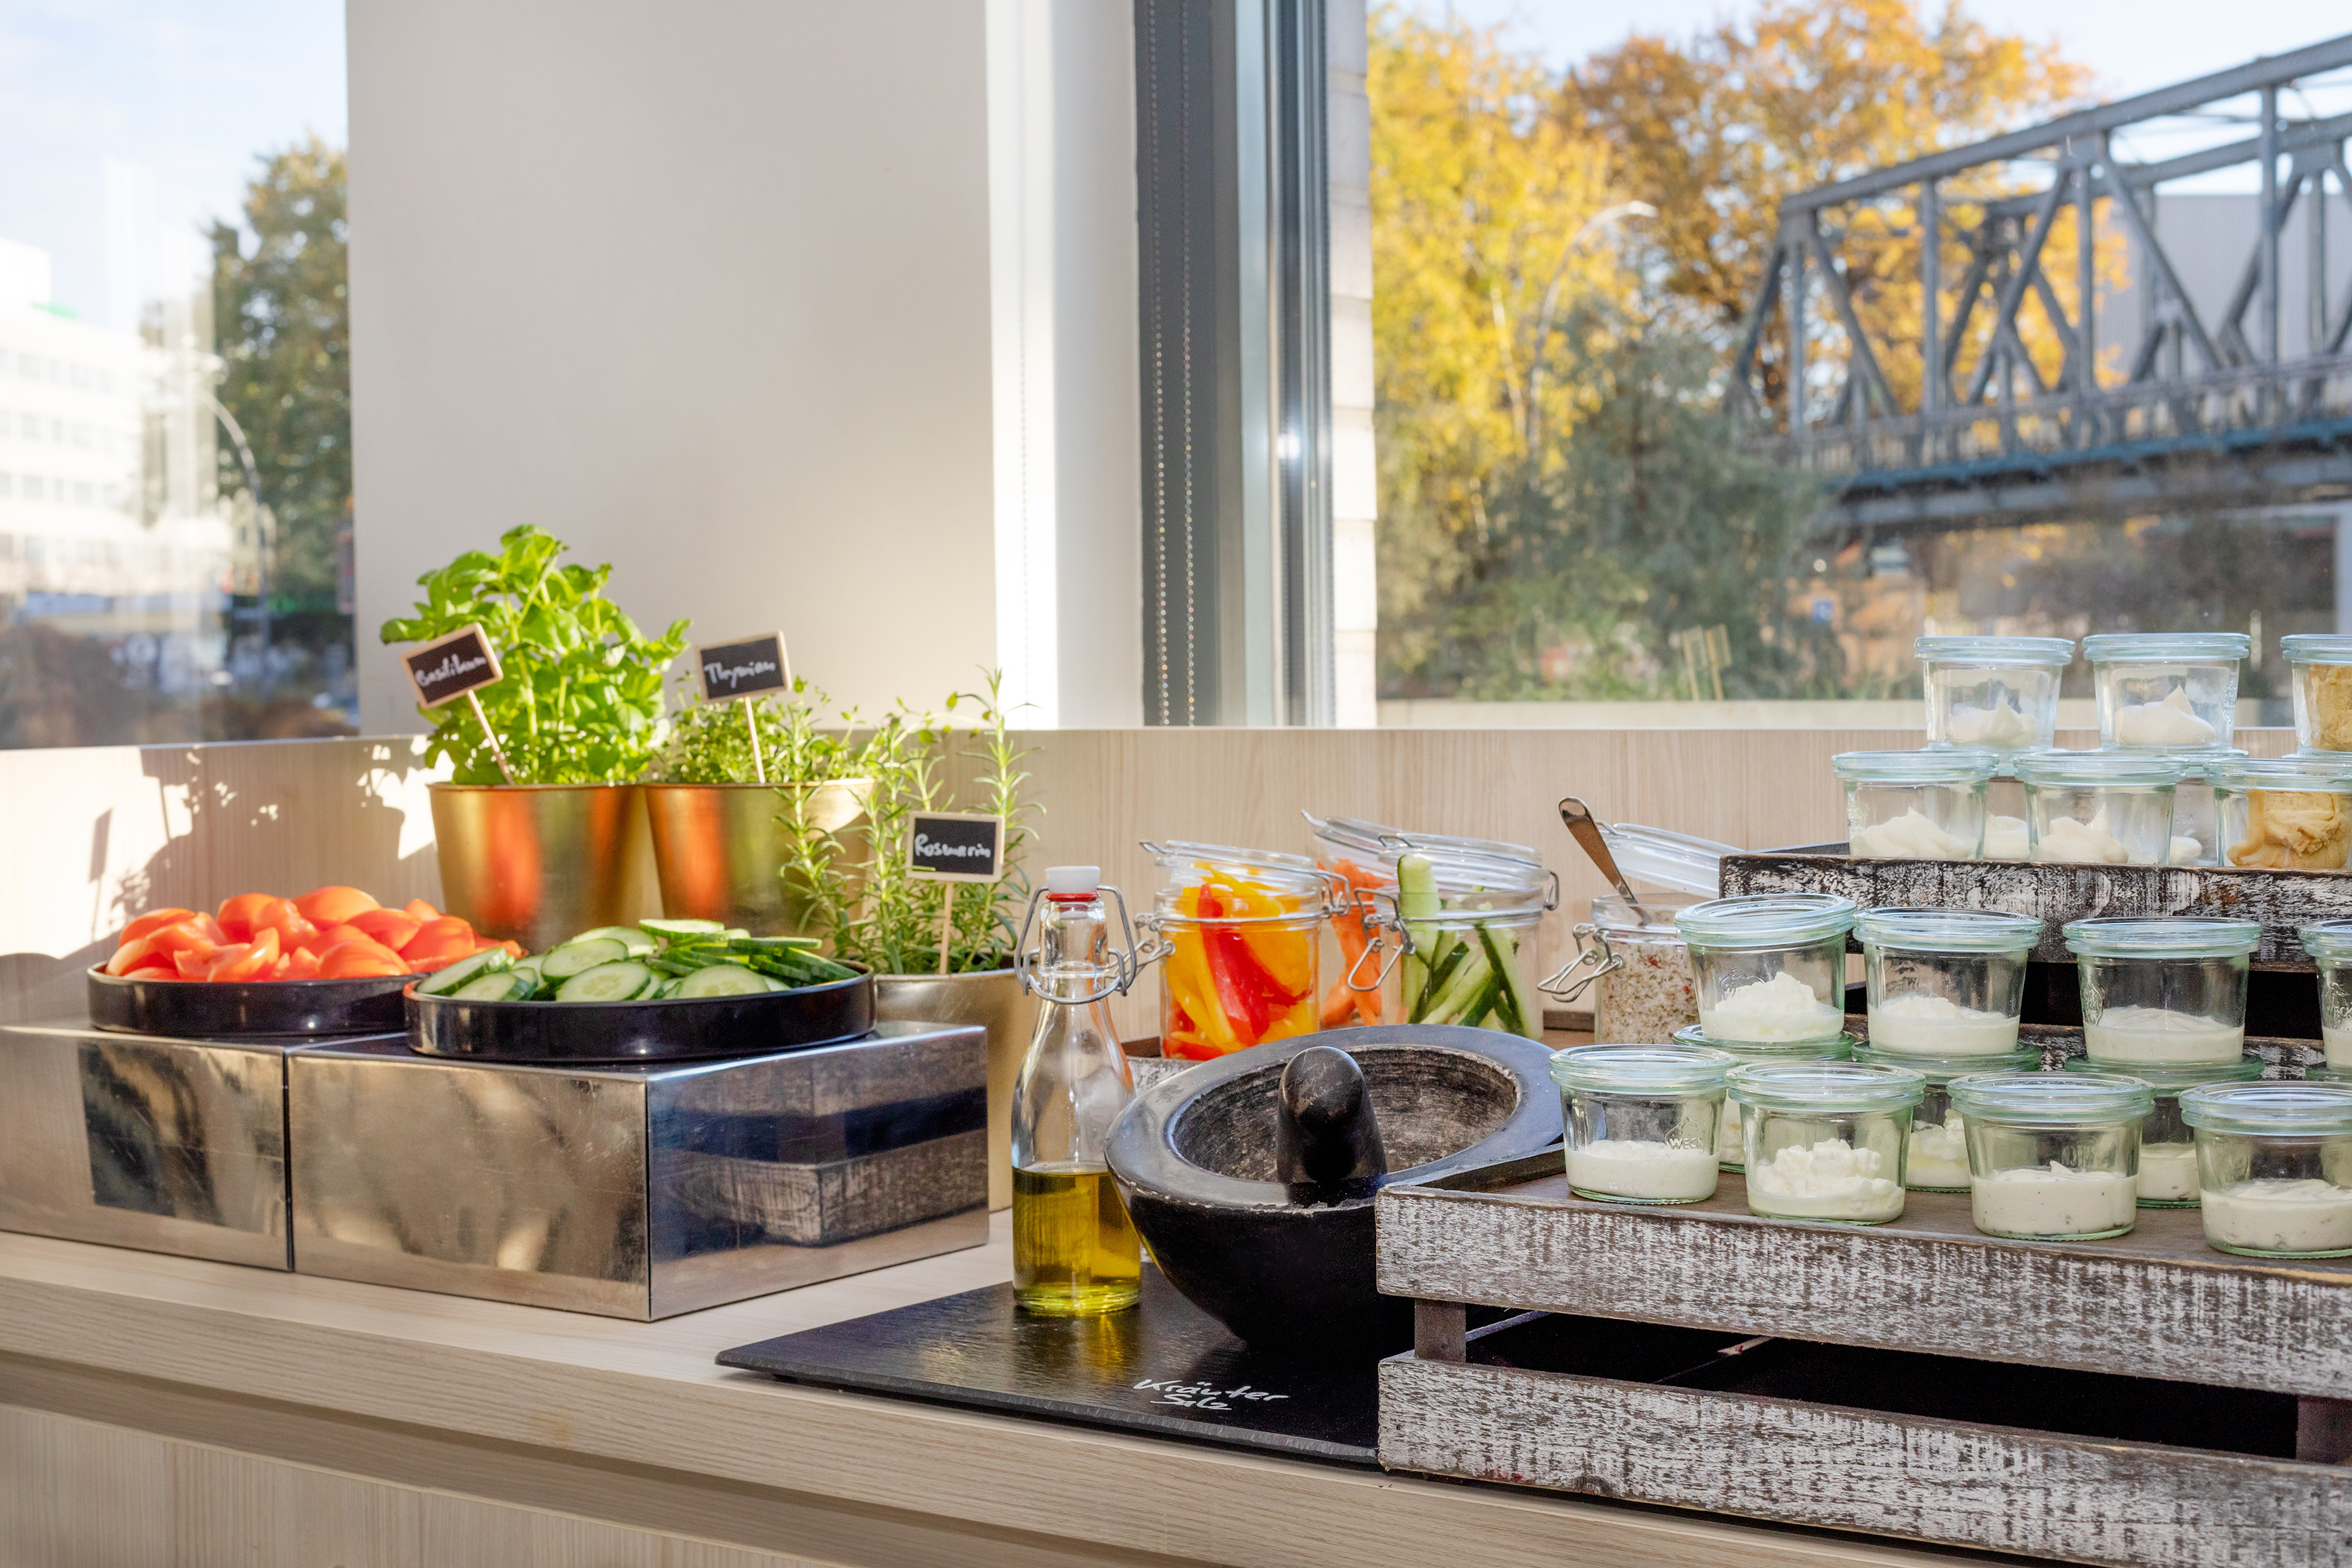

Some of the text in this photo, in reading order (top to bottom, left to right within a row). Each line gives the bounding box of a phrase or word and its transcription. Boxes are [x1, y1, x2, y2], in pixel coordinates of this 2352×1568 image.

[703, 661, 776, 689] Thymian
[914, 832, 992, 858] Rosmarin
[1667, 1137, 1704, 1150] WECK
[1133, 1378, 1290, 1401] Kräuter
[1150, 1393, 1233, 1411] Salz
